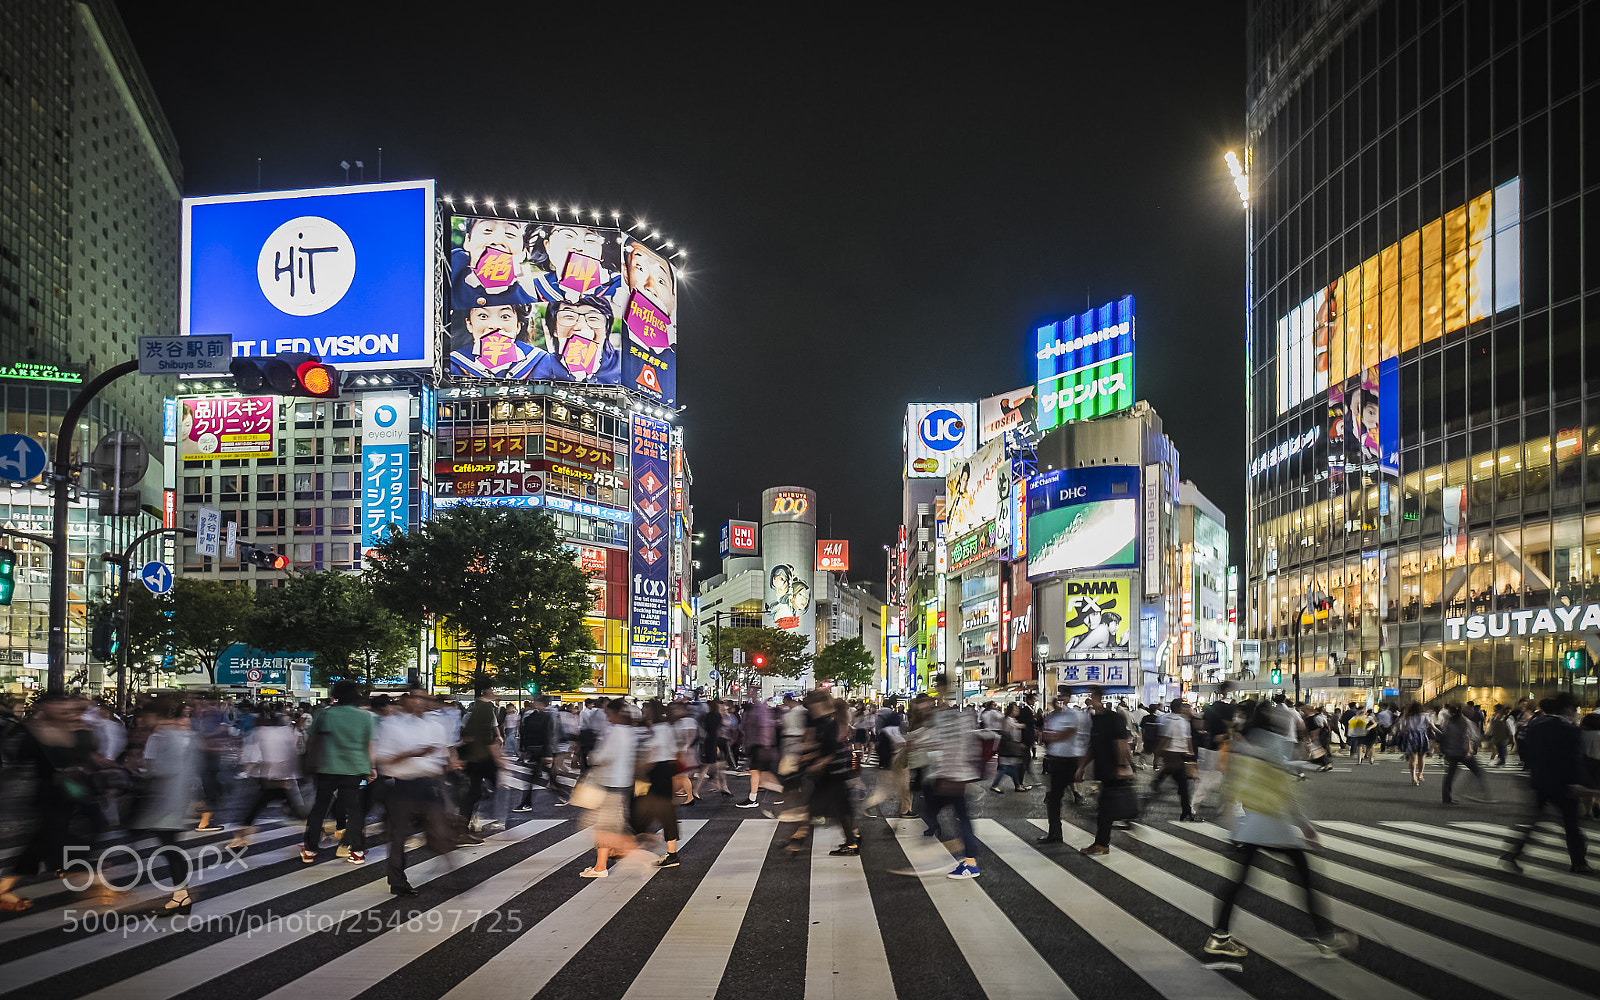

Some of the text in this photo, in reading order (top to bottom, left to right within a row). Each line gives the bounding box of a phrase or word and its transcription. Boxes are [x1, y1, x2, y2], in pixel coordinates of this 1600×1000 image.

[477, 254, 597, 292] 絶 叫
[146, 339, 224, 359] 渋谷駅前
[231, 333, 398, 357] IT LED VISION
[483, 336, 512, 365] 学
[567, 339, 598, 369] 割
[14, 362, 59, 372] SHIBUYA
[158, 358, 215, 371] Shibuya Sta.
[42, 370, 81, 380] CITY
[1041, 372, 1127, 413] サロンパス
[195, 399, 271, 419] 品川スキン
[195, 416, 271, 435] クリニック
[991, 413, 1016, 431] LOSER
[368, 430, 403, 439] eyecity
[545, 438, 613, 465] コンタクト
[634, 436, 643, 455] 2
[497, 460, 531, 474] ガスト
[437, 482, 453, 493] 7F
[457, 480, 475, 489] Café
[477, 478, 519, 496] ガスト
[593, 472, 624, 489] ガスト
[367, 453, 386, 538] アイシティ
[1060, 486, 1087, 501] DHC
[12, 512, 54, 521] SHIBU
[771, 497, 809, 518] 109
[3, 520, 44, 530] ARK
[734, 528, 751, 538] UNI
[734, 537, 752, 546] QLO
[823, 543, 842, 556] H&M
[1147, 526, 1155, 562] neon
[633, 574, 666, 597] f(x)
[1067, 581, 1119, 596] DMM
[1067, 595, 1102, 613] FX
[1012, 604, 1031, 651] クスリ
[1446, 603, 1600, 640] TSUTAYA
[1057, 665, 1123, 681] 堂書店
